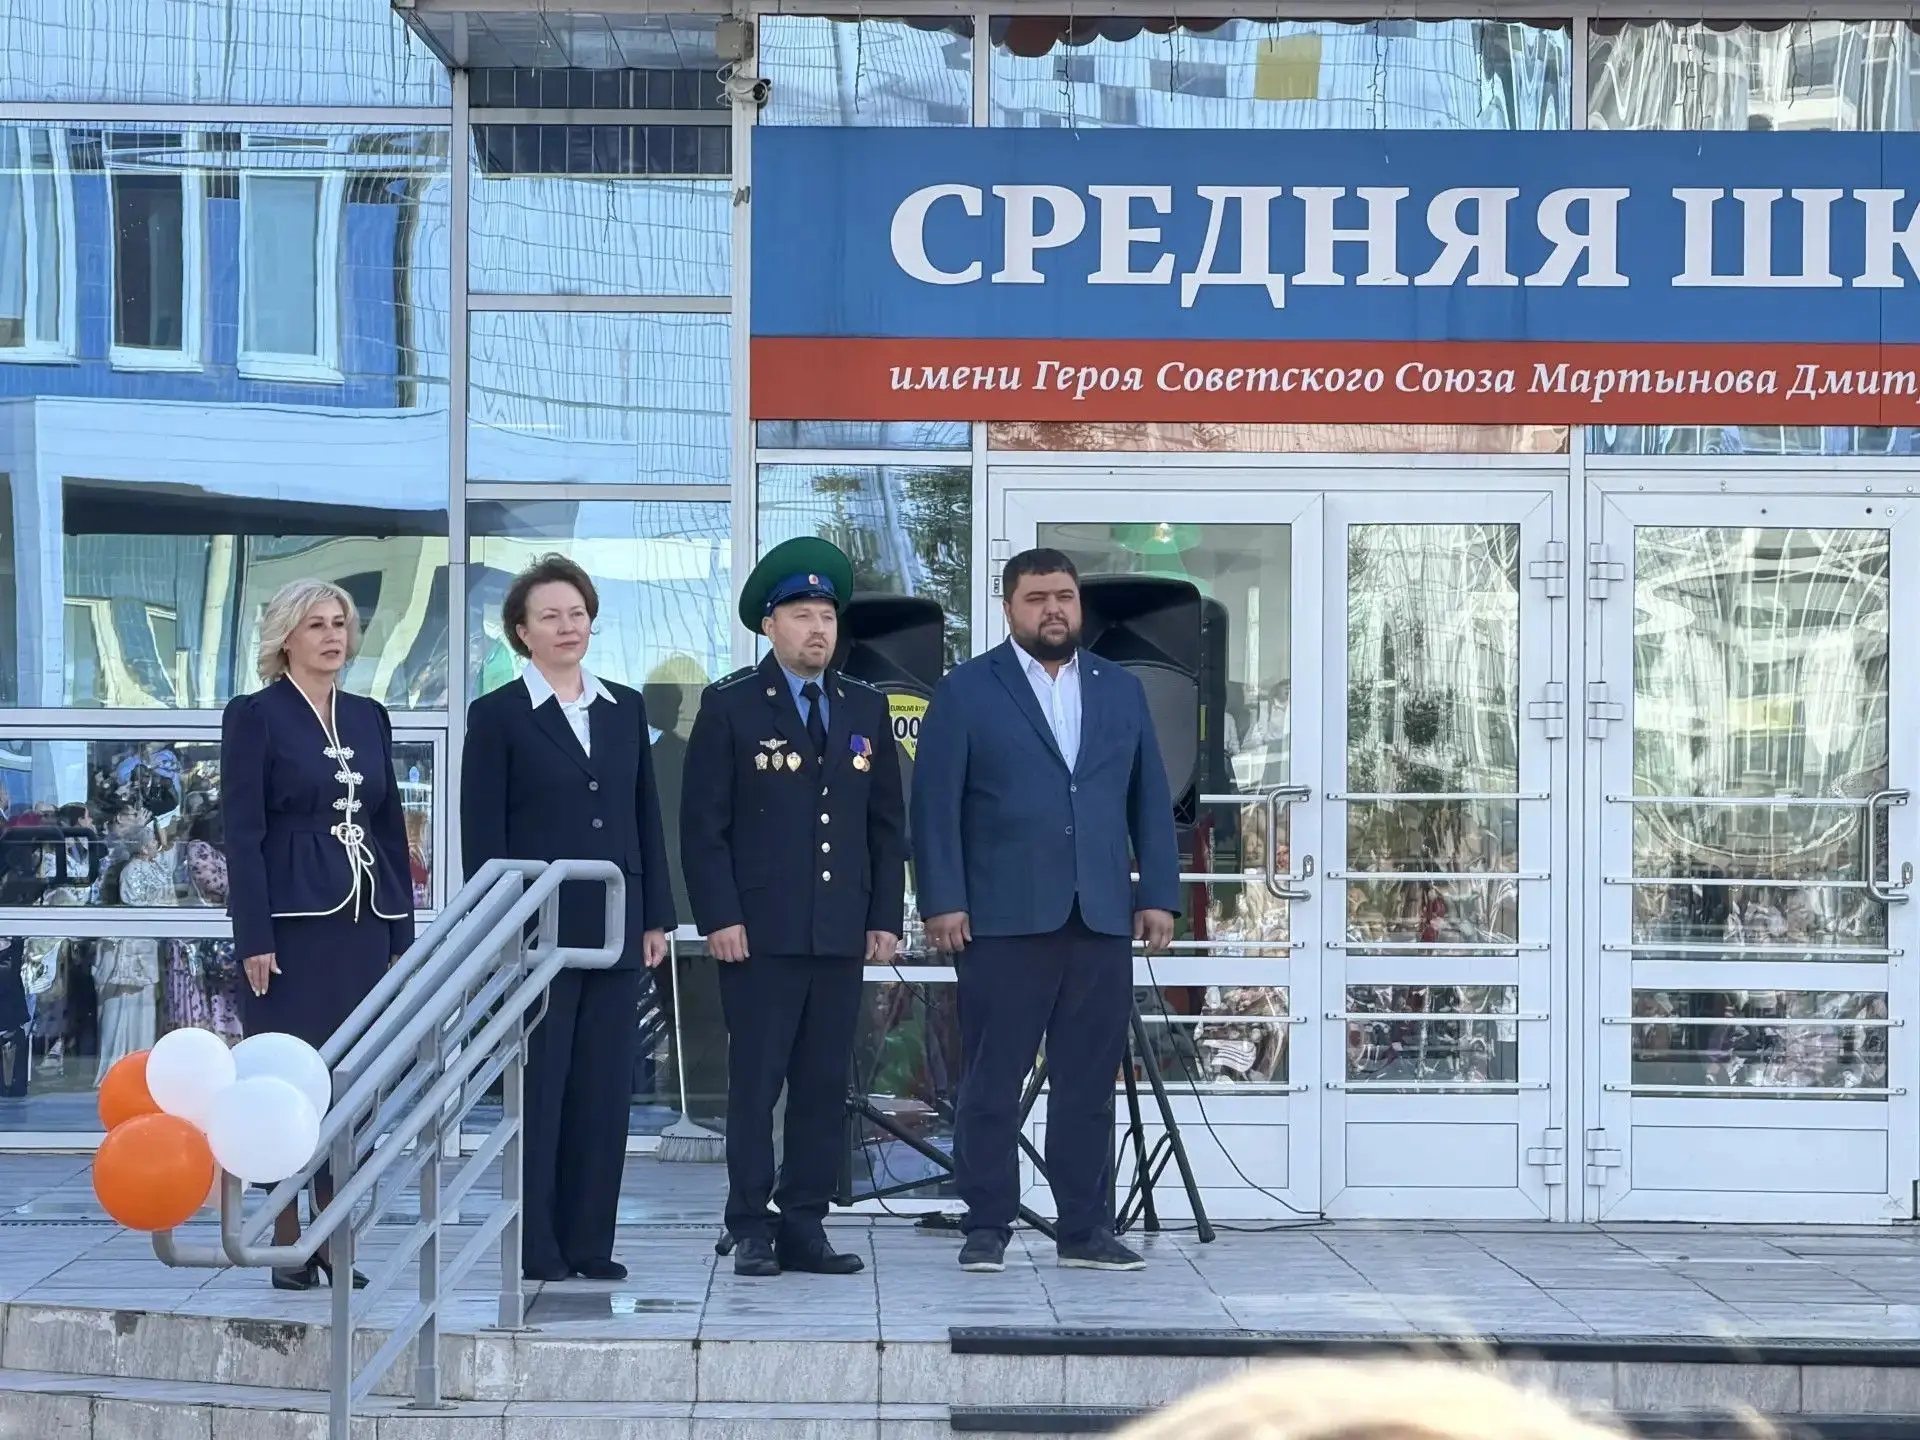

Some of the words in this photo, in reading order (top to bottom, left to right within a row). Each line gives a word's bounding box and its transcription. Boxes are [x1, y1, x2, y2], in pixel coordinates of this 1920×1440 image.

[890, 183, 1630, 309] СРЕДНЯЯ
[1671, 187, 1920, 288] ШК
[889, 365, 1022, 391] имени
[1031, 360, 1144, 400] Героя
[1156, 361, 1385, 393] Советского
[1395, 361, 1516, 394] Союза
[1526, 362, 1778, 403] Мартынова
[1785, 363, 1920, 404] Дмит
